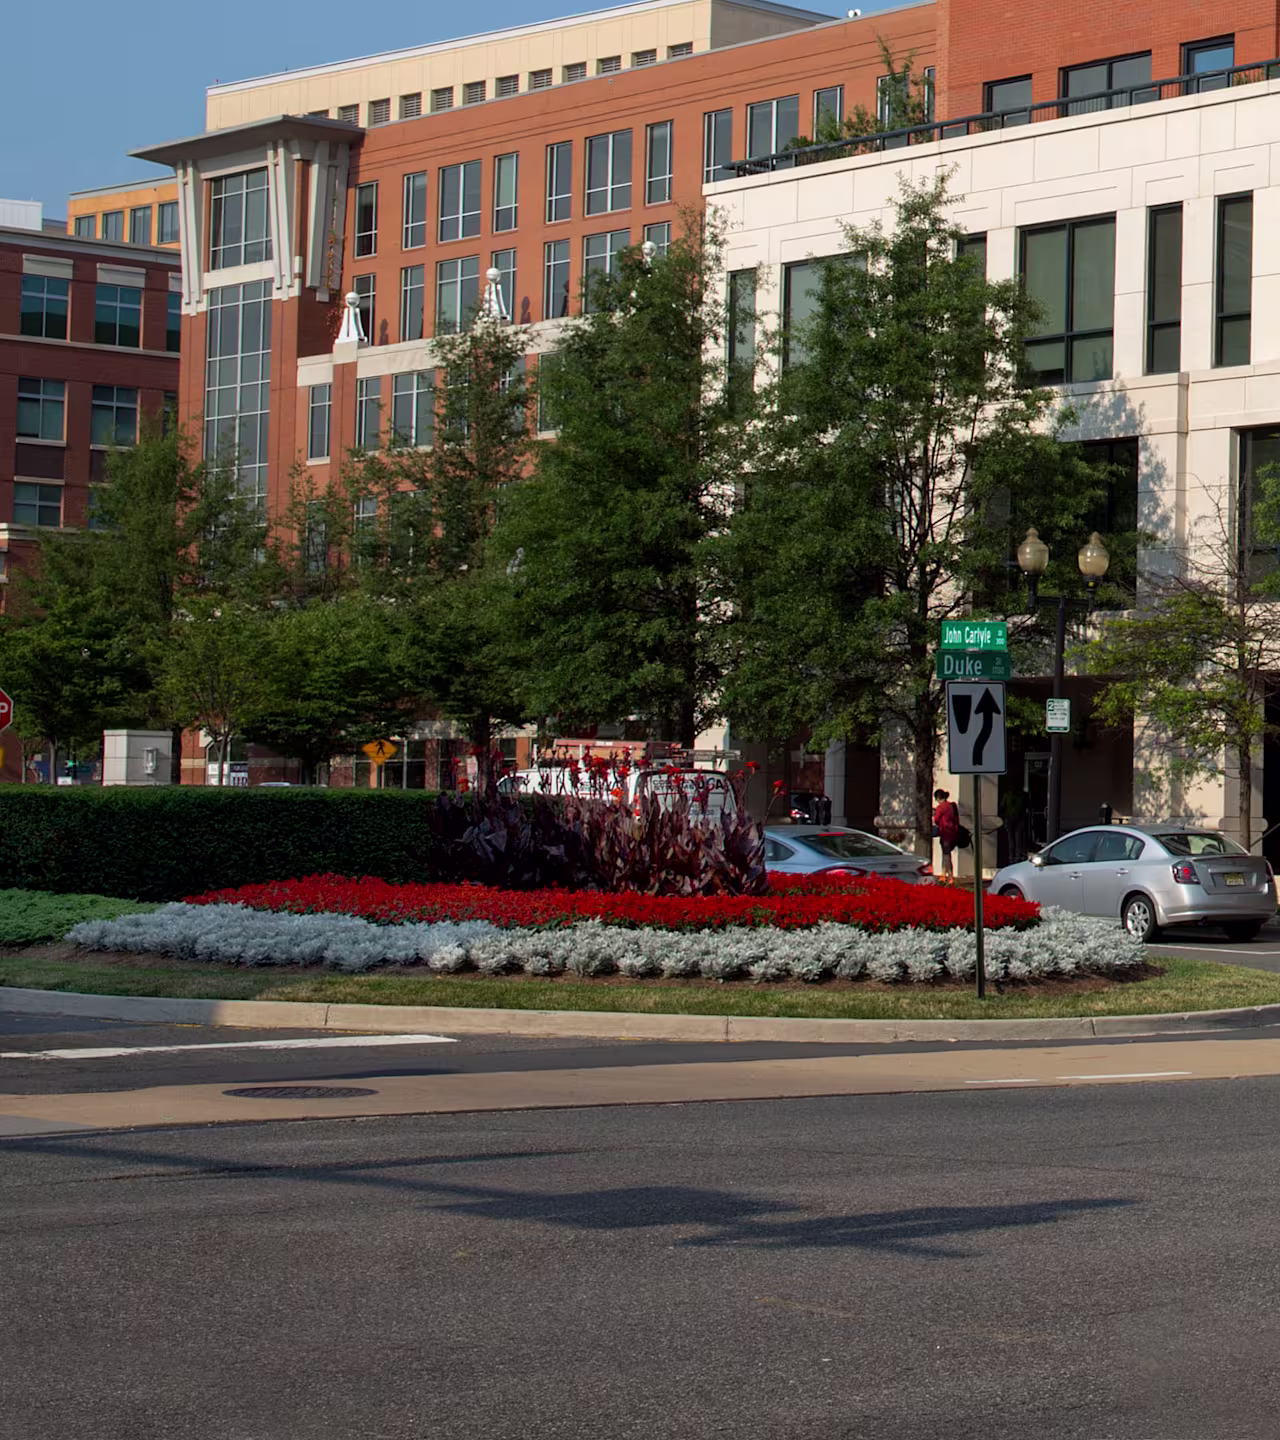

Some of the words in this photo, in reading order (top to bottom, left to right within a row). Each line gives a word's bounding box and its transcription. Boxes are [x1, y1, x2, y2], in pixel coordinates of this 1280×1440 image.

[944, 627, 962, 643] John
[964, 626, 991, 648] Carlyle
[944, 655, 983, 675] Duke
[1048, 701, 1054, 710] 2
